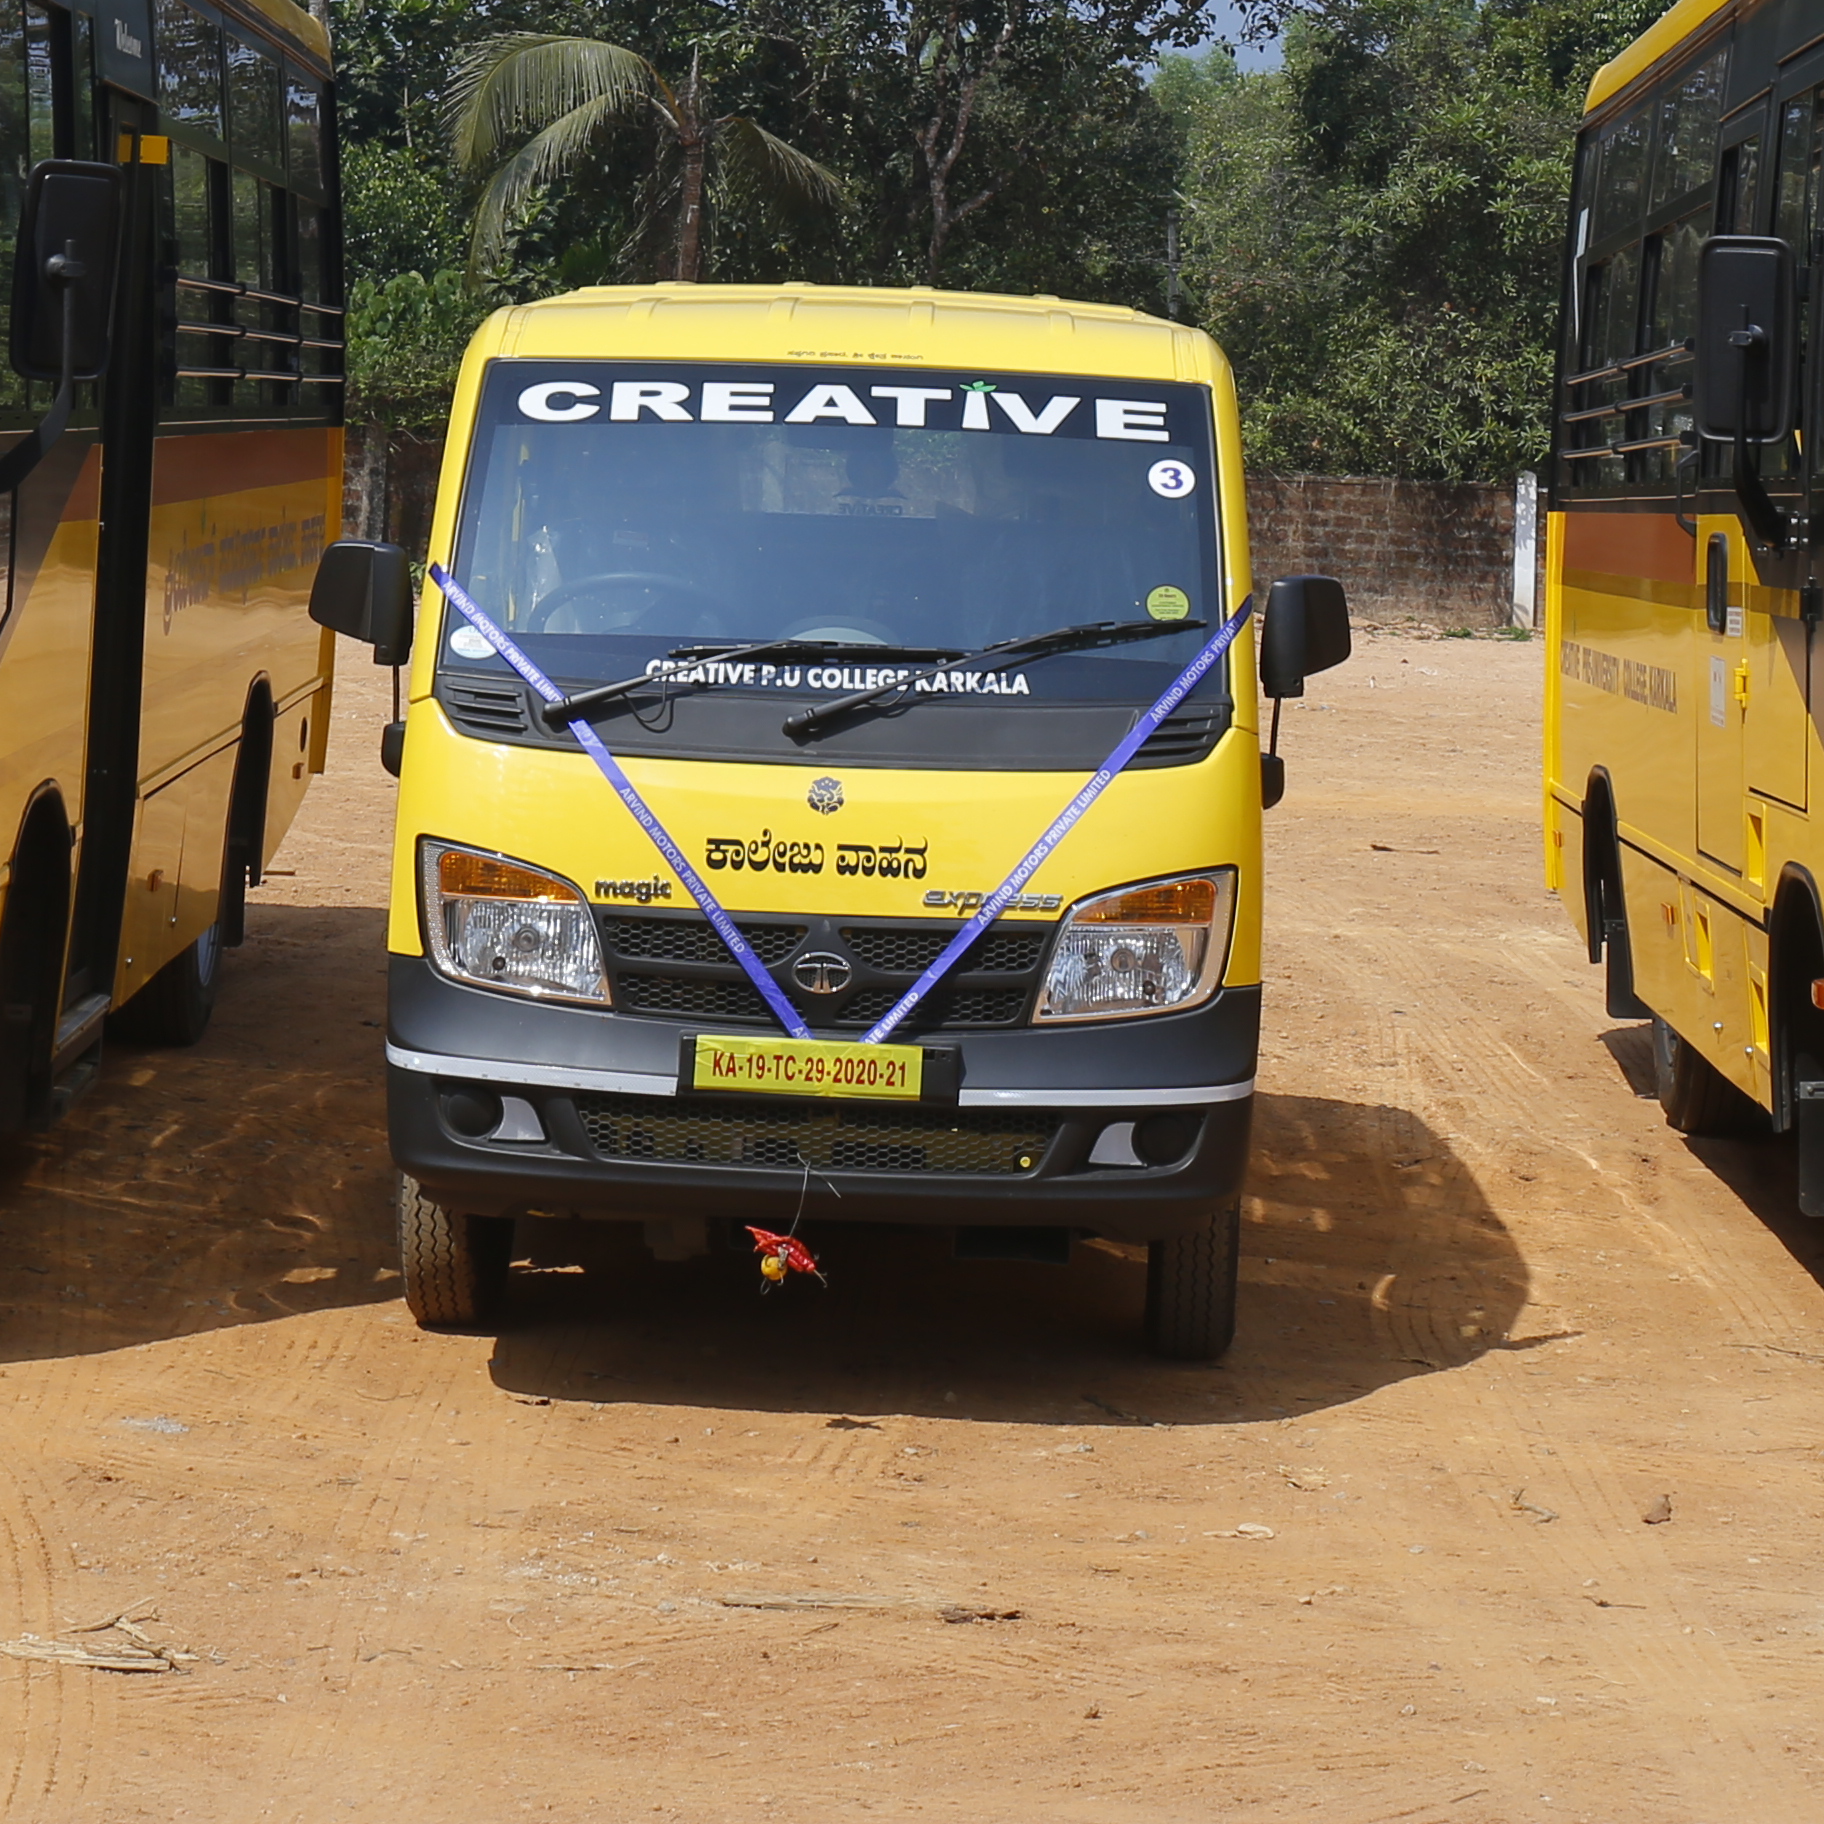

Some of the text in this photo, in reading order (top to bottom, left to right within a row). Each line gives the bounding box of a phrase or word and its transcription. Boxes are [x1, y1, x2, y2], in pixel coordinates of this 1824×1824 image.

[518, 381, 1171, 443] CREATIVE
[1159, 466, 1184, 490] 3
[442, 580, 475, 615] ARVIND
[471, 611, 510, 650] MOTORS
[503, 646, 542, 685] PRIVATE
[535, 679, 564, 703] LIMIT
[645, 659, 1030, 695] CREATIVE P.U COLLEGE KARKALA
[1149, 688, 1183, 724] ARVIND
[1179, 650, 1215, 690] MOTORS
[619, 786, 746, 954] ARVIND MOTORS PRIVATE LIMITED
[706, 828, 929, 879] ಕಾಲೇಜು ವಾಹನ
[977, 769, 1111, 927] ARVIND MOTORS PRIVATE LIMITED
[595, 873, 672, 902] magic
[881, 991, 920, 1028] LIMITED
[712, 1050, 907, 1088] KA-19-TC-29-2020-21
